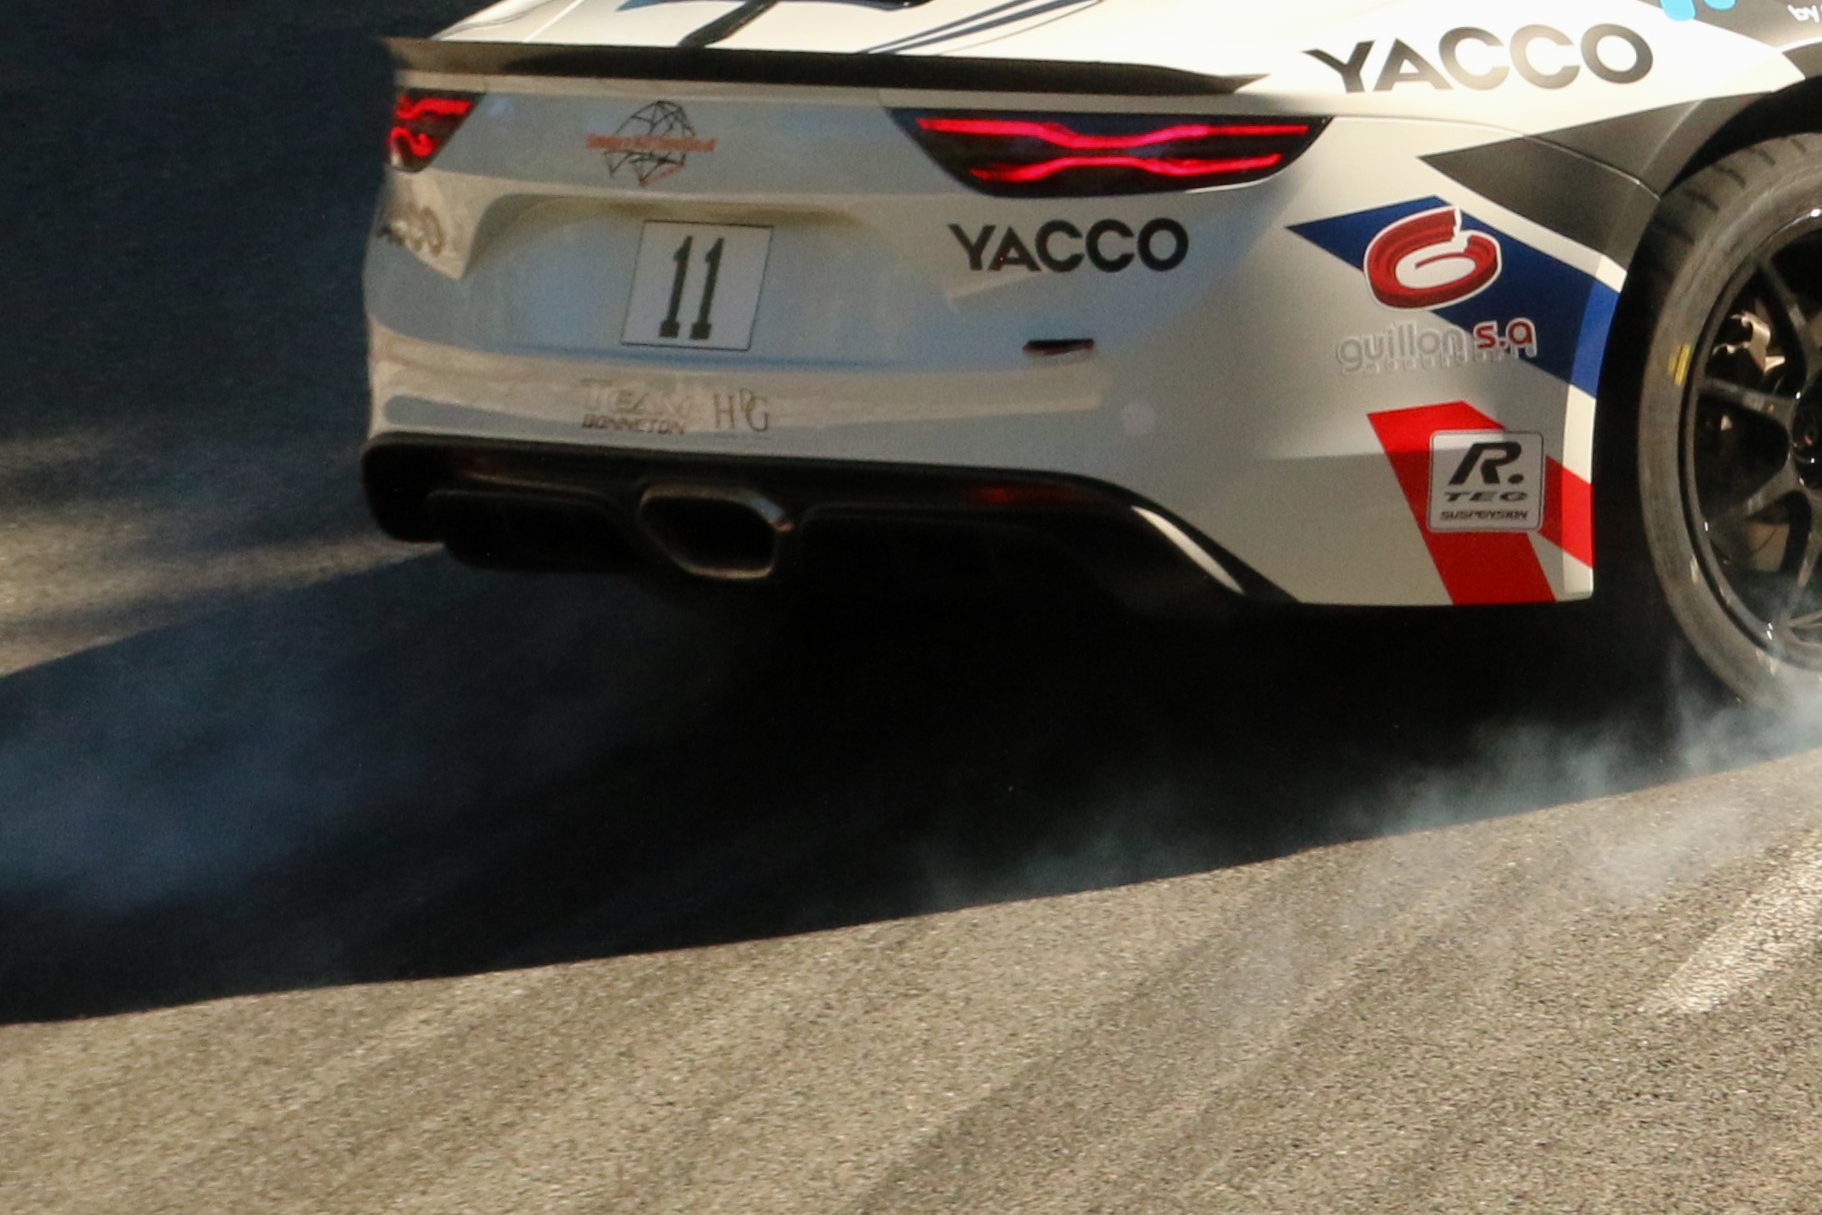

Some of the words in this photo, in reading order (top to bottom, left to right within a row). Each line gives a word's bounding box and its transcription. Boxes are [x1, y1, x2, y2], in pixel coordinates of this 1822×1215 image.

[1788, 3, 1820, 23] by
[1300, 23, 1653, 94] YACCO
[947, 217, 1190, 274] YACCO
[659, 234, 725, 341] 11
[1337, 322, 1468, 375] guillon
